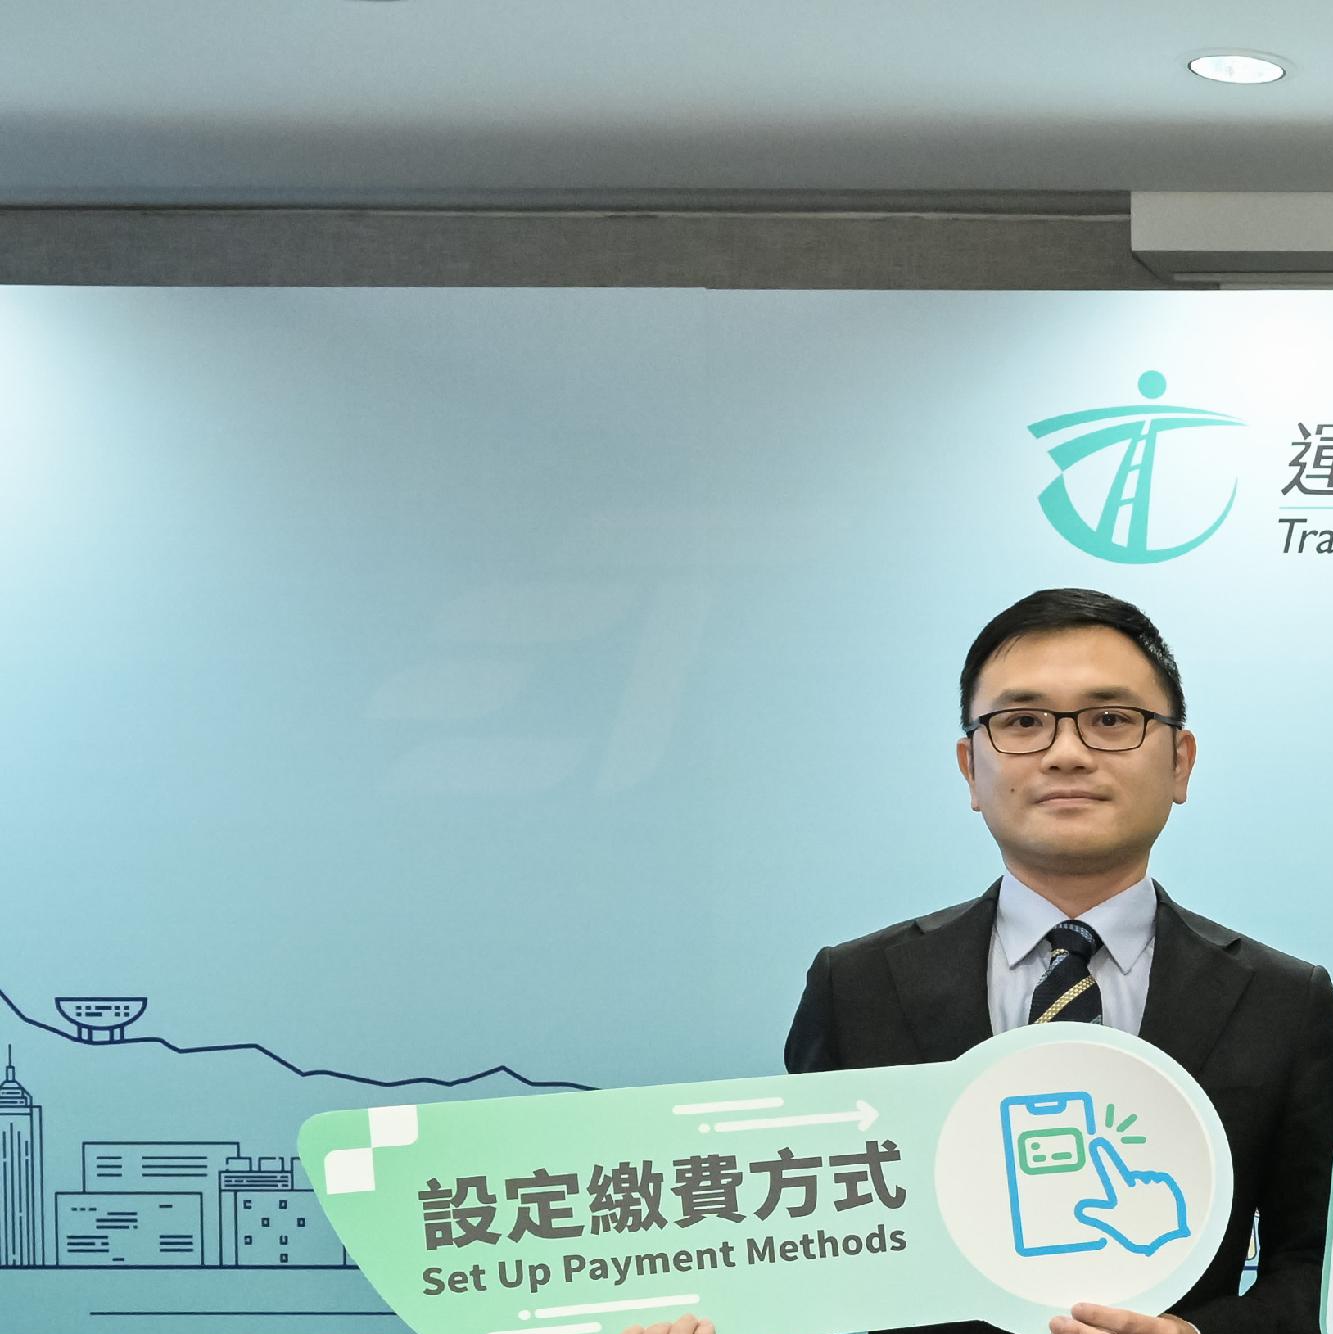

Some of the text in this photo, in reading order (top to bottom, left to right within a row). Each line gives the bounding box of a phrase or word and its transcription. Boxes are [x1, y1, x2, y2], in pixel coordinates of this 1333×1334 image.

[417, 1140, 907, 1250] 設定繳費方式
[422, 1224, 907, 1296] Set Up Payment Methods
